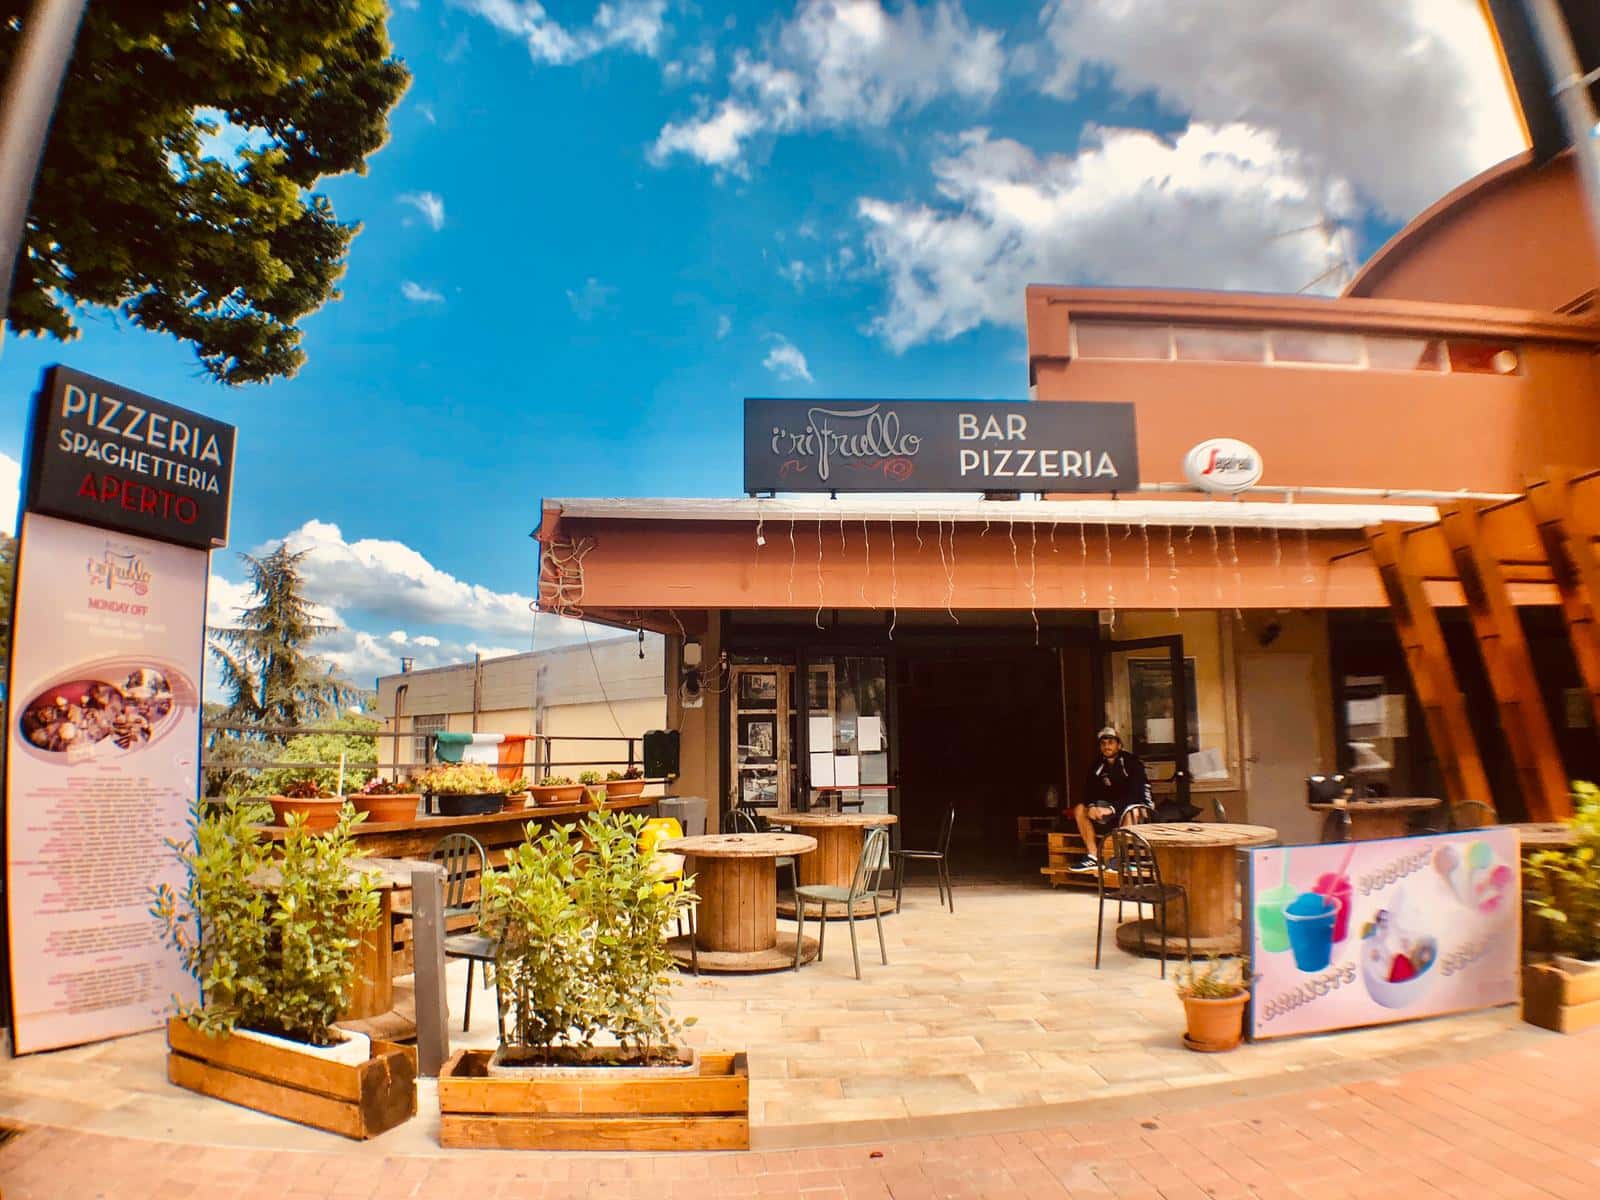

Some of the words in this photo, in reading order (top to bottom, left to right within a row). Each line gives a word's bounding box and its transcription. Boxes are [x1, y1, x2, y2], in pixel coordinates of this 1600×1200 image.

[61, 384, 221, 466] PIZZERIA
[958, 413, 1027, 441] BAR
[58, 429, 220, 494] SPAGHETTERIA
[960, 450, 1119, 478] PIZZERIA
[78, 472, 198, 525] APERTO
[88, 598, 130, 613] MONDAY
[130, 604, 149, 616] OFF
